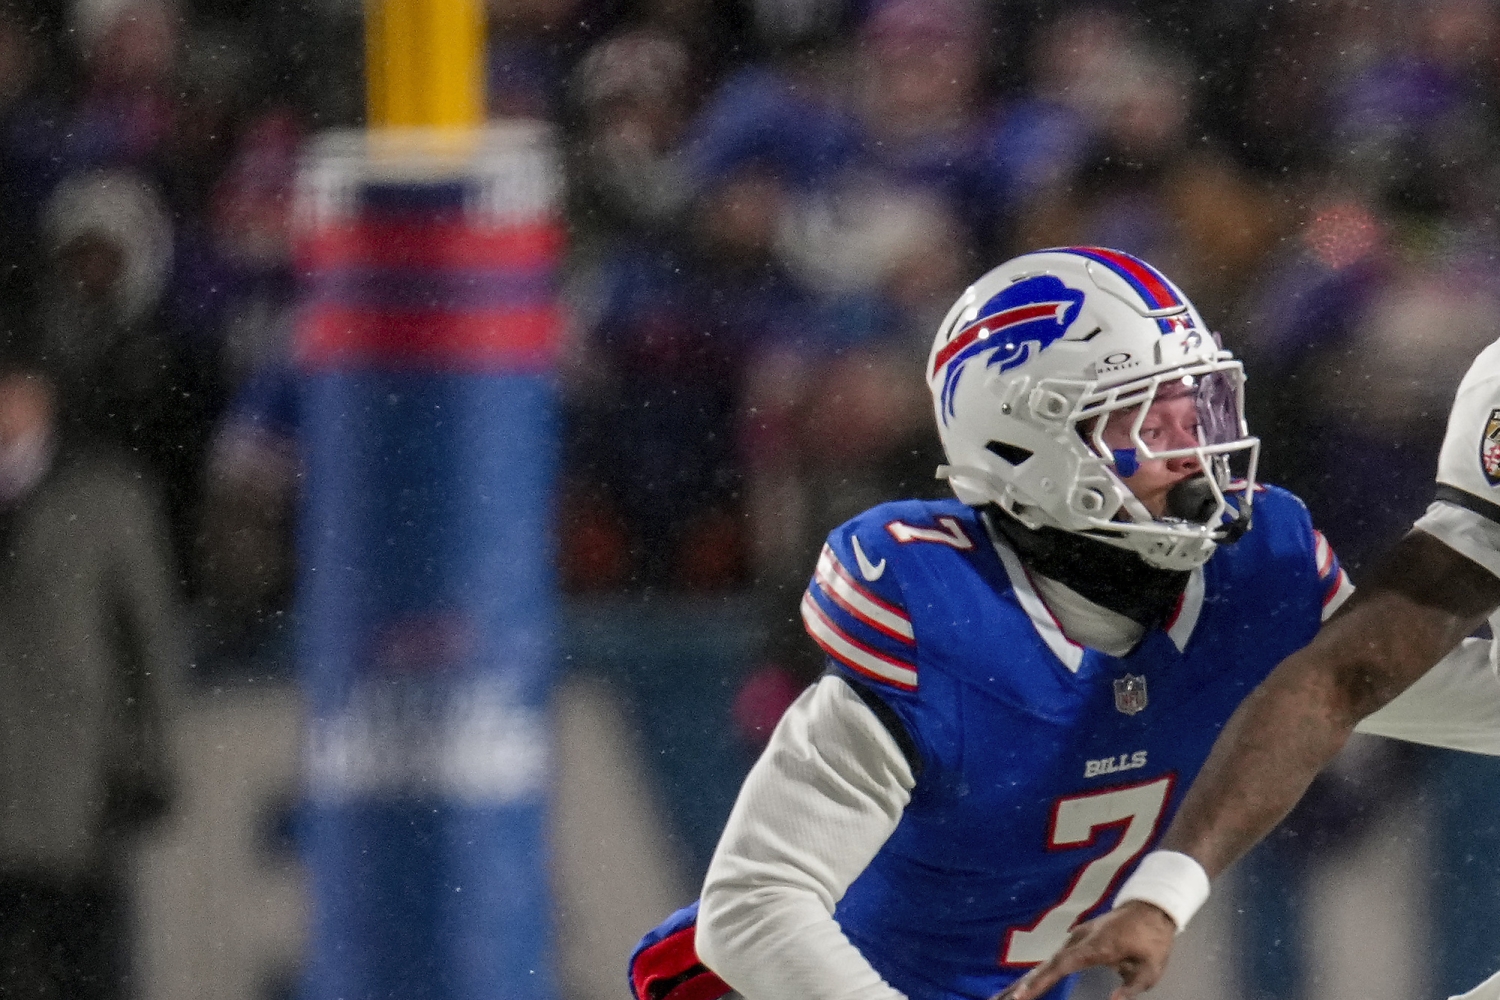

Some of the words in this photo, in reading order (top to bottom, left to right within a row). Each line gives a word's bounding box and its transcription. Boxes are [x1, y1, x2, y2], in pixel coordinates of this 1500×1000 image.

[883, 516, 977, 552] 7
[1083, 750, 1148, 778] BILLS
[999, 771, 1178, 969] 7
